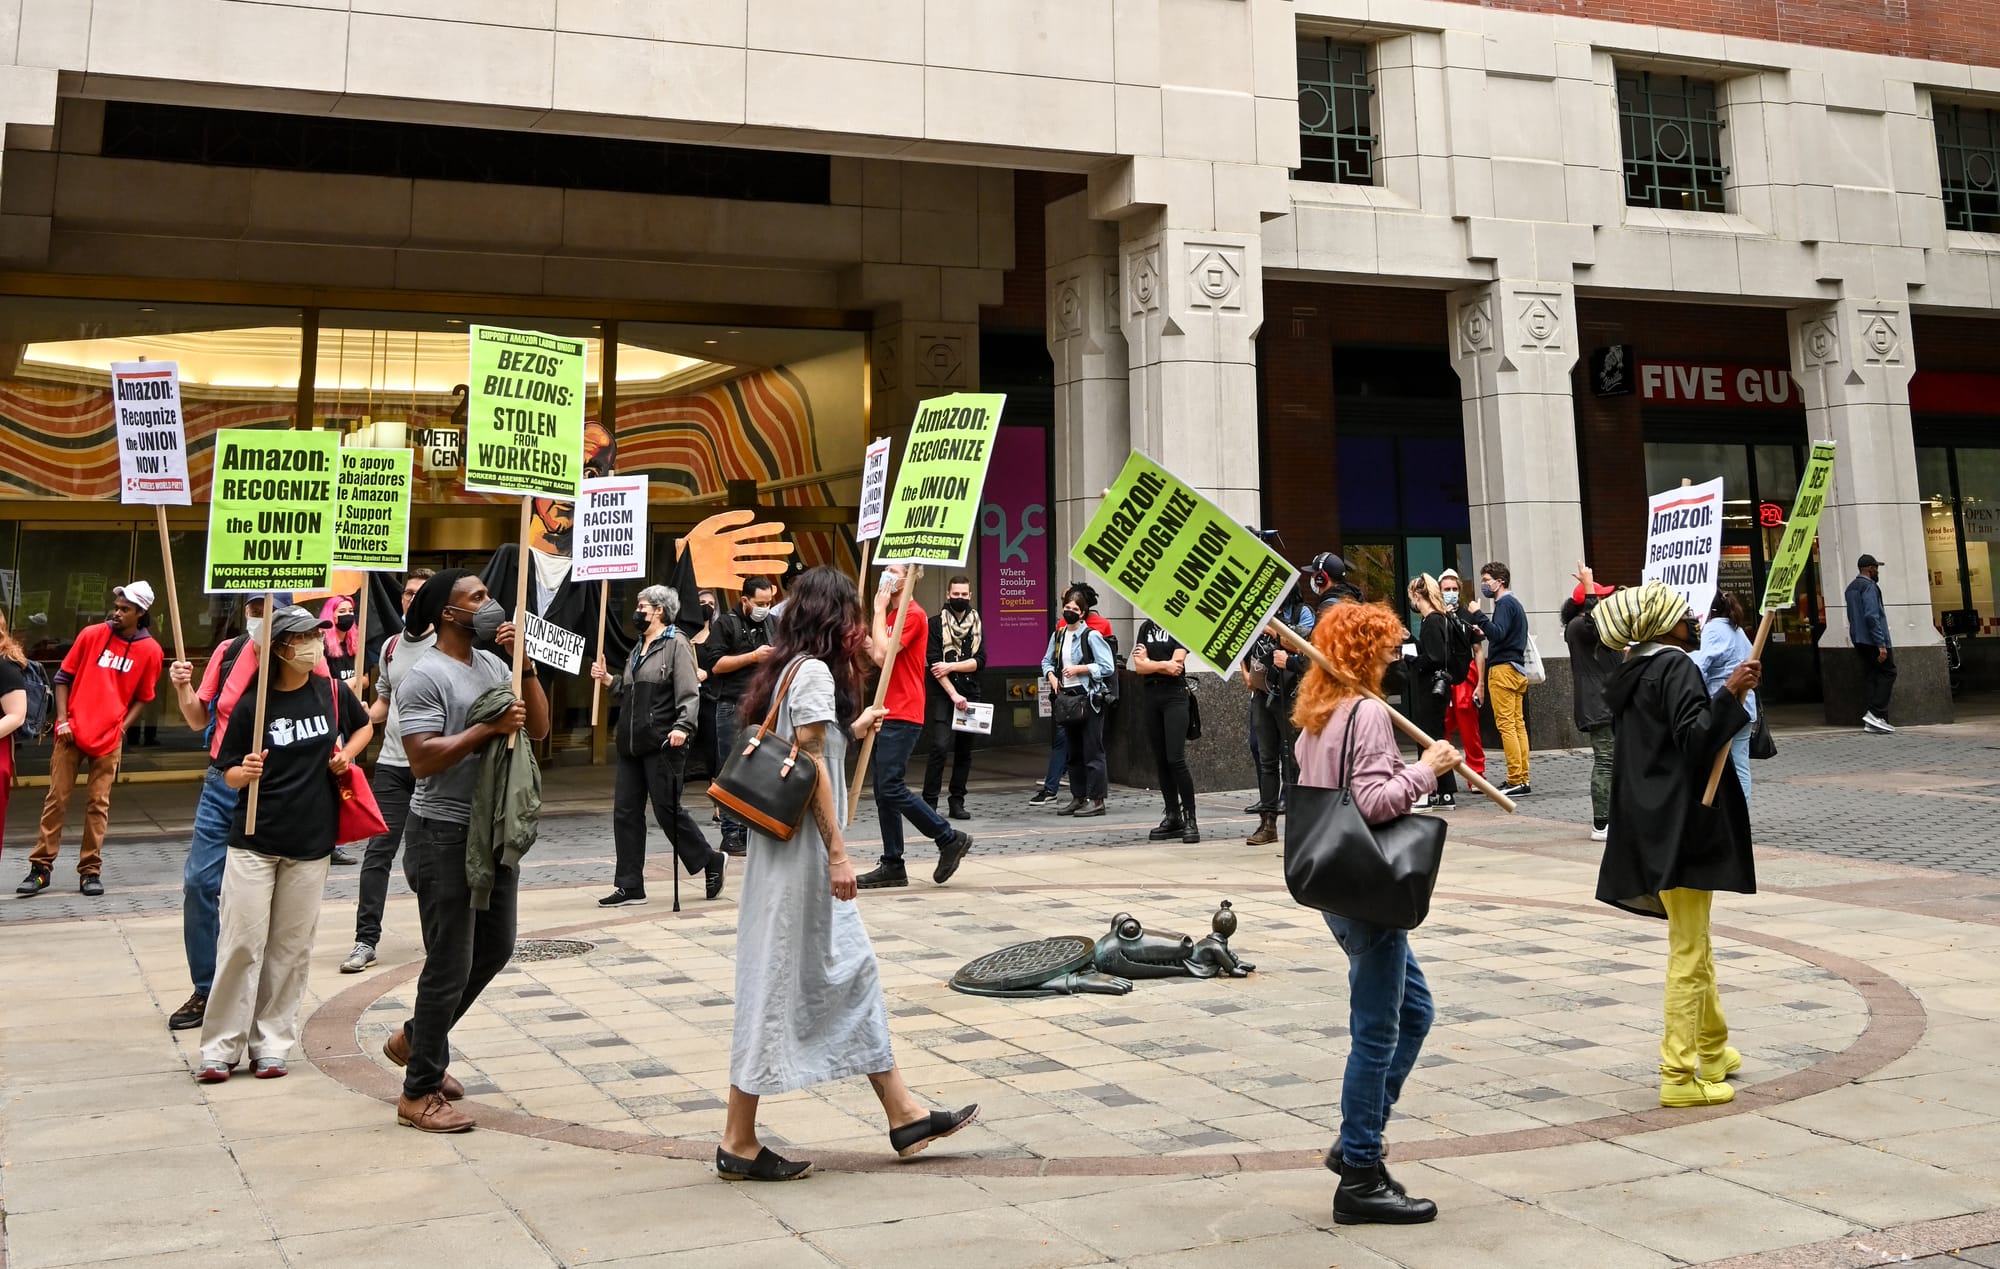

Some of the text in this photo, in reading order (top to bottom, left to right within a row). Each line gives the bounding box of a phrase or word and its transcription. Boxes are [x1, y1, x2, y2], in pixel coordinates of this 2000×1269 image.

[510, 334, 538, 345] AMAZON
[498, 350, 563, 377] BEZOS'
[118, 379, 173, 400] Amazon:
[483, 375, 574, 406] BILLIONS:
[1641, 365, 1726, 400] FIVE
[1736, 368, 1793, 403] GU
[121, 407, 176, 428] Recognize
[493, 407, 557, 438] STOLEN
[916, 407, 990, 433] Amazon:
[126, 431, 177, 451] the UNION
[416, 429, 460, 447] METR
[514, 434, 538, 448] FROM
[222, 444, 330, 471] Amazon:
[479, 443, 567, 477] WORKERS!
[909, 438, 985, 463] RECOGNIZE
[136, 456, 168, 473] NOW !
[342, 454, 394, 471] Yo apoyo
[468, 472, 496, 481] WORKERS
[223, 479, 330, 501] RECOGNIZE
[351, 487, 398, 502] Amazon
[902, 476, 970, 501] the UNION
[591, 492, 627, 508] FIGHT
[226, 511, 322, 534] the UNION
[346, 505, 392, 521] Support
[584, 510, 633, 527] RACISM
[904, 506, 939, 529] NOW
[940, 507, 948, 528] !
[1083, 471, 1167, 574] Amazon:
[1651, 505, 1713, 537] Amazon:
[1965, 509, 1992, 520] OPEN
[335, 520, 389, 536] #Amazon
[584, 528, 633, 544] & UNION
[1968, 523, 1976, 533] 11
[1978, 525, 1992, 533] am
[243, 539, 303, 561] NOW !
[338, 536, 388, 551] Workers
[883, 534, 962, 547] WORKERS ASSEMBLY
[1118, 487, 1199, 594] RECOGNIZE
[1650, 536, 1712, 564] Recognize
[583, 544, 634, 559] BUSTING!
[887, 547, 950, 559] AGAINST RACISM
[214, 567, 326, 576] WORKERS ASSEMBLY
[1000, 568, 1026, 576] Where
[1163, 519, 1232, 618] the UNION
[1662, 562, 1708, 586] UNION
[224, 579, 313, 588] AGAINST RACISM
[1000, 578, 1036, 587] Brooklyn
[1000, 588, 1026, 596] Comes
[1194, 555, 1251, 624] NOW !
[1000, 597, 1034, 607] Together
[1205, 559, 1278, 659] WORKERS ASSEMBLY
[1227, 576, 1286, 660] AGAINST RACISM
[547, 625, 584, 656] BUSTER-
[110, 655, 134, 673] ALU
[296, 715, 329, 741] ALU
